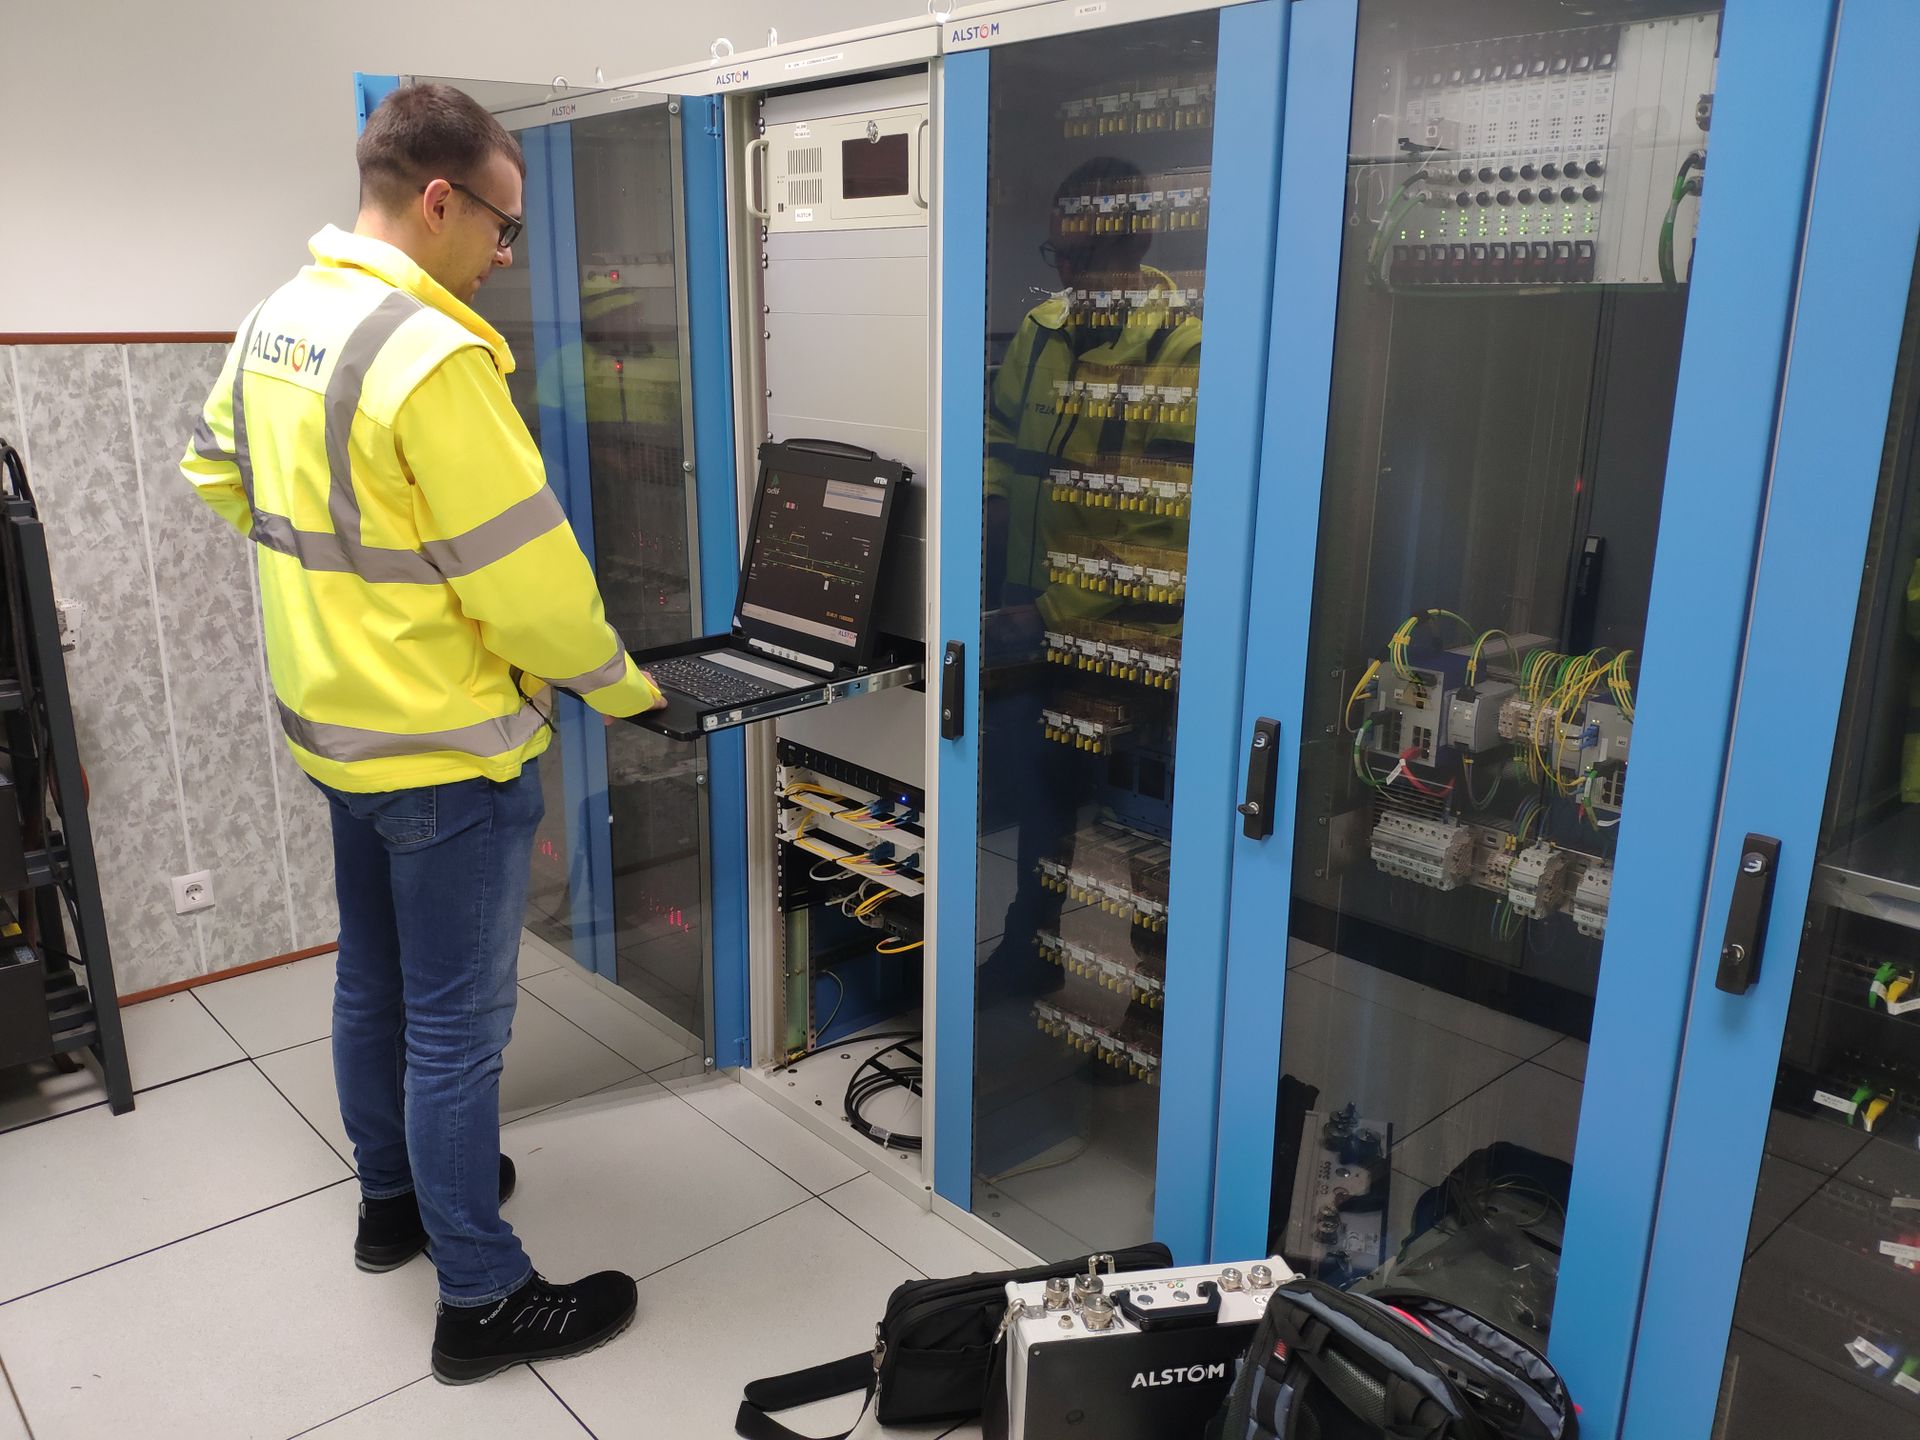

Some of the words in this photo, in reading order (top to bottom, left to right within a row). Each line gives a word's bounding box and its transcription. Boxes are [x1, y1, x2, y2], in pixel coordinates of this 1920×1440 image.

[952, 22, 1000, 43] ALSTOM
[716, 69, 749, 86] ALSTOM
[551, 103, 576, 117] ALSTOM
[250, 330, 327, 376] ALSTOM
[1131, 1362, 1226, 1389] ALSTOM
